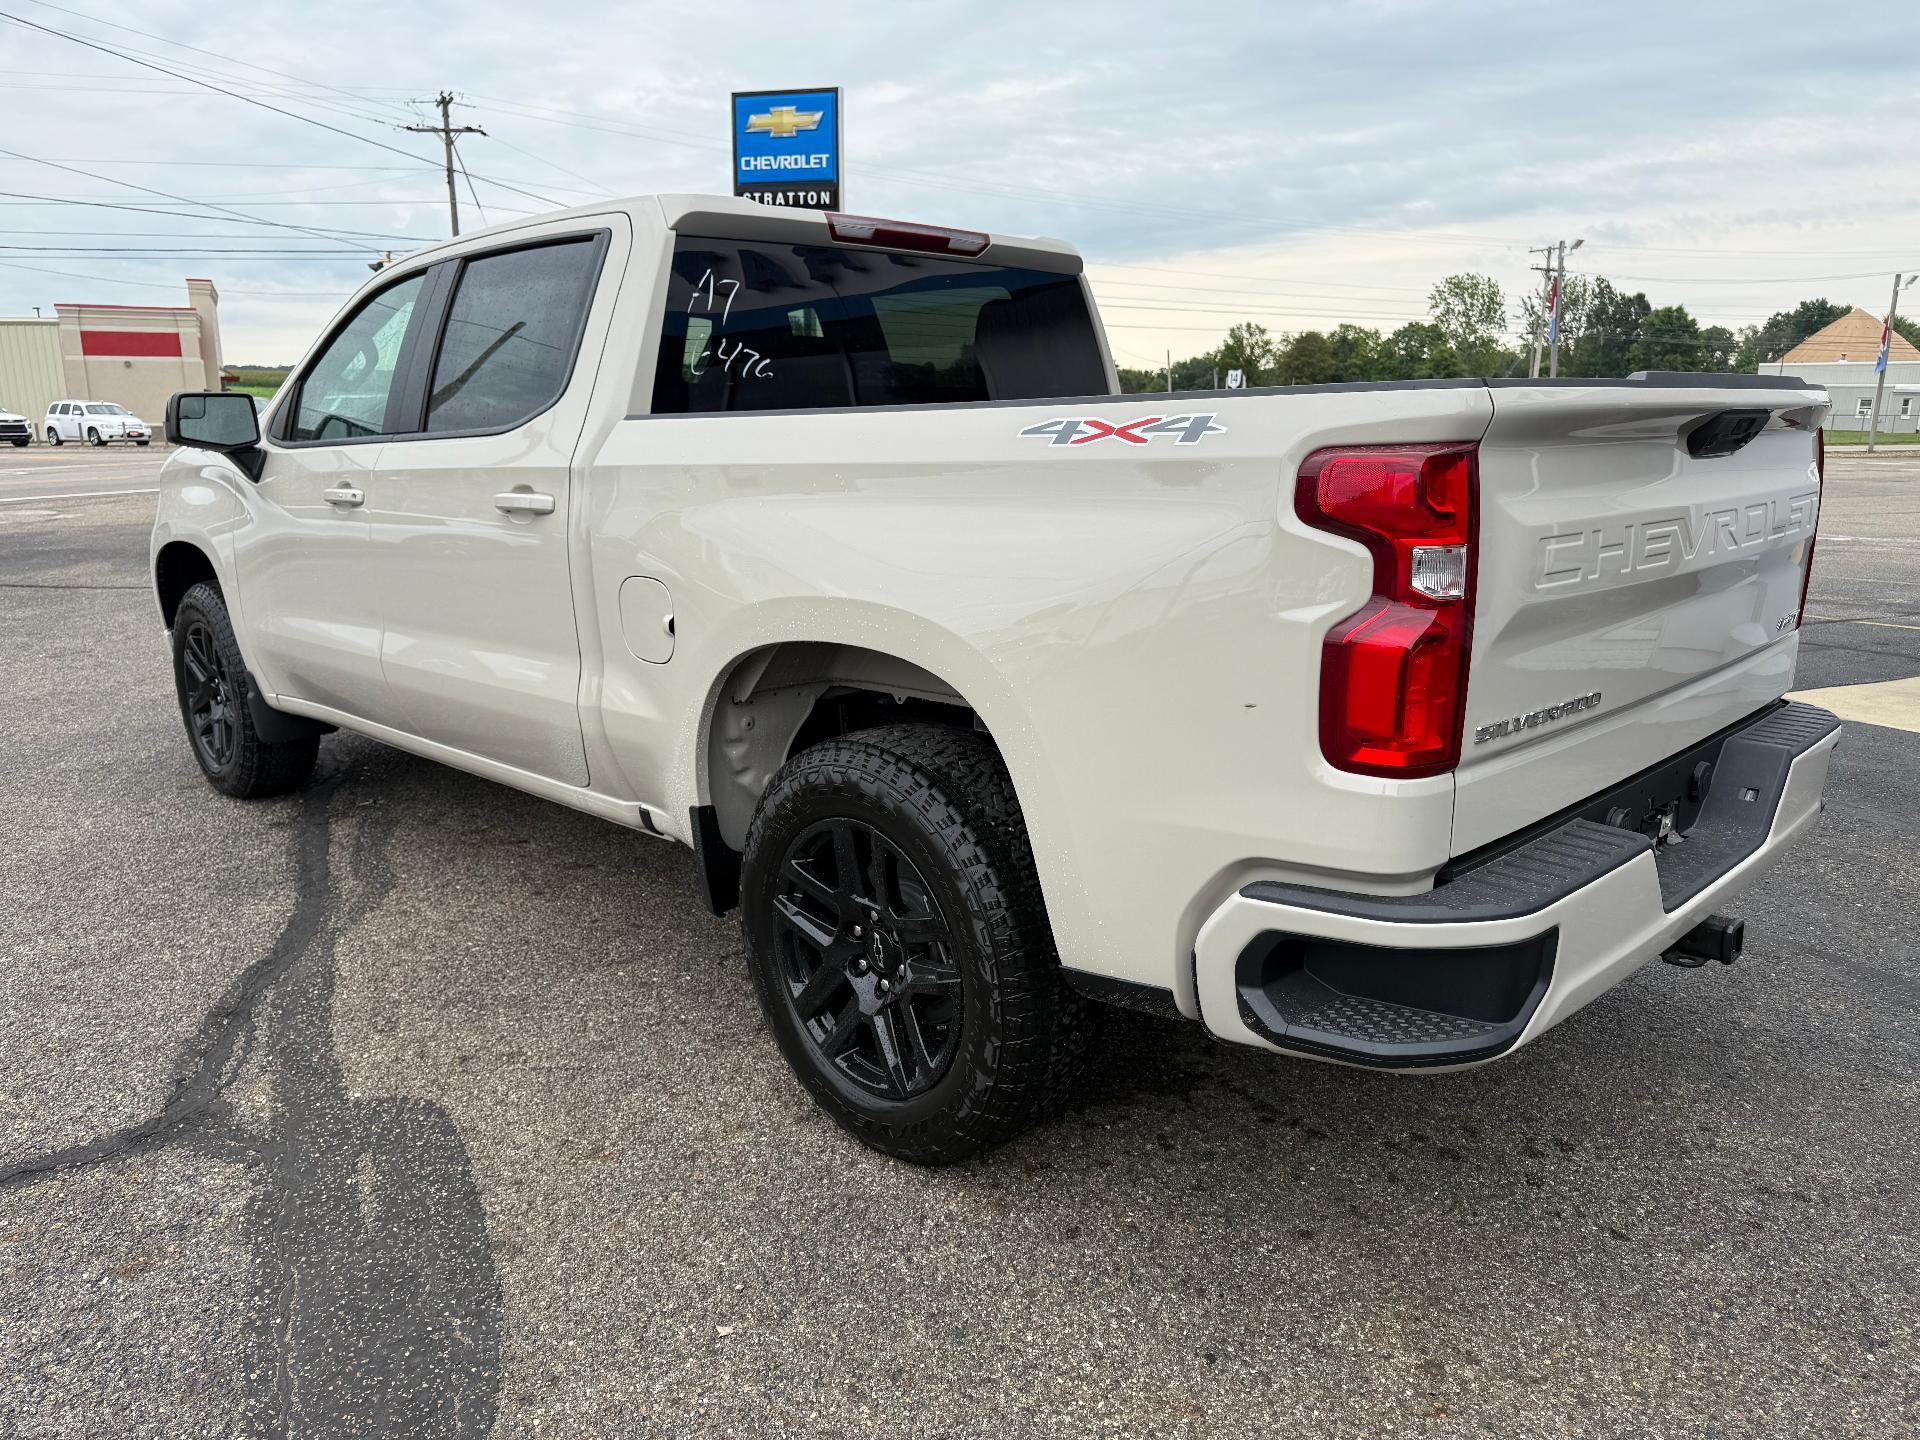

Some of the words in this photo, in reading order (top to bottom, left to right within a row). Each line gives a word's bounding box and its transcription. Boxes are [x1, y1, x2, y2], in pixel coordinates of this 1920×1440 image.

[741, 154, 830, 170] CHEVROLET
[1535, 491, 1818, 589] CHEVROLET
[1474, 692, 1602, 745] SILVERADO
